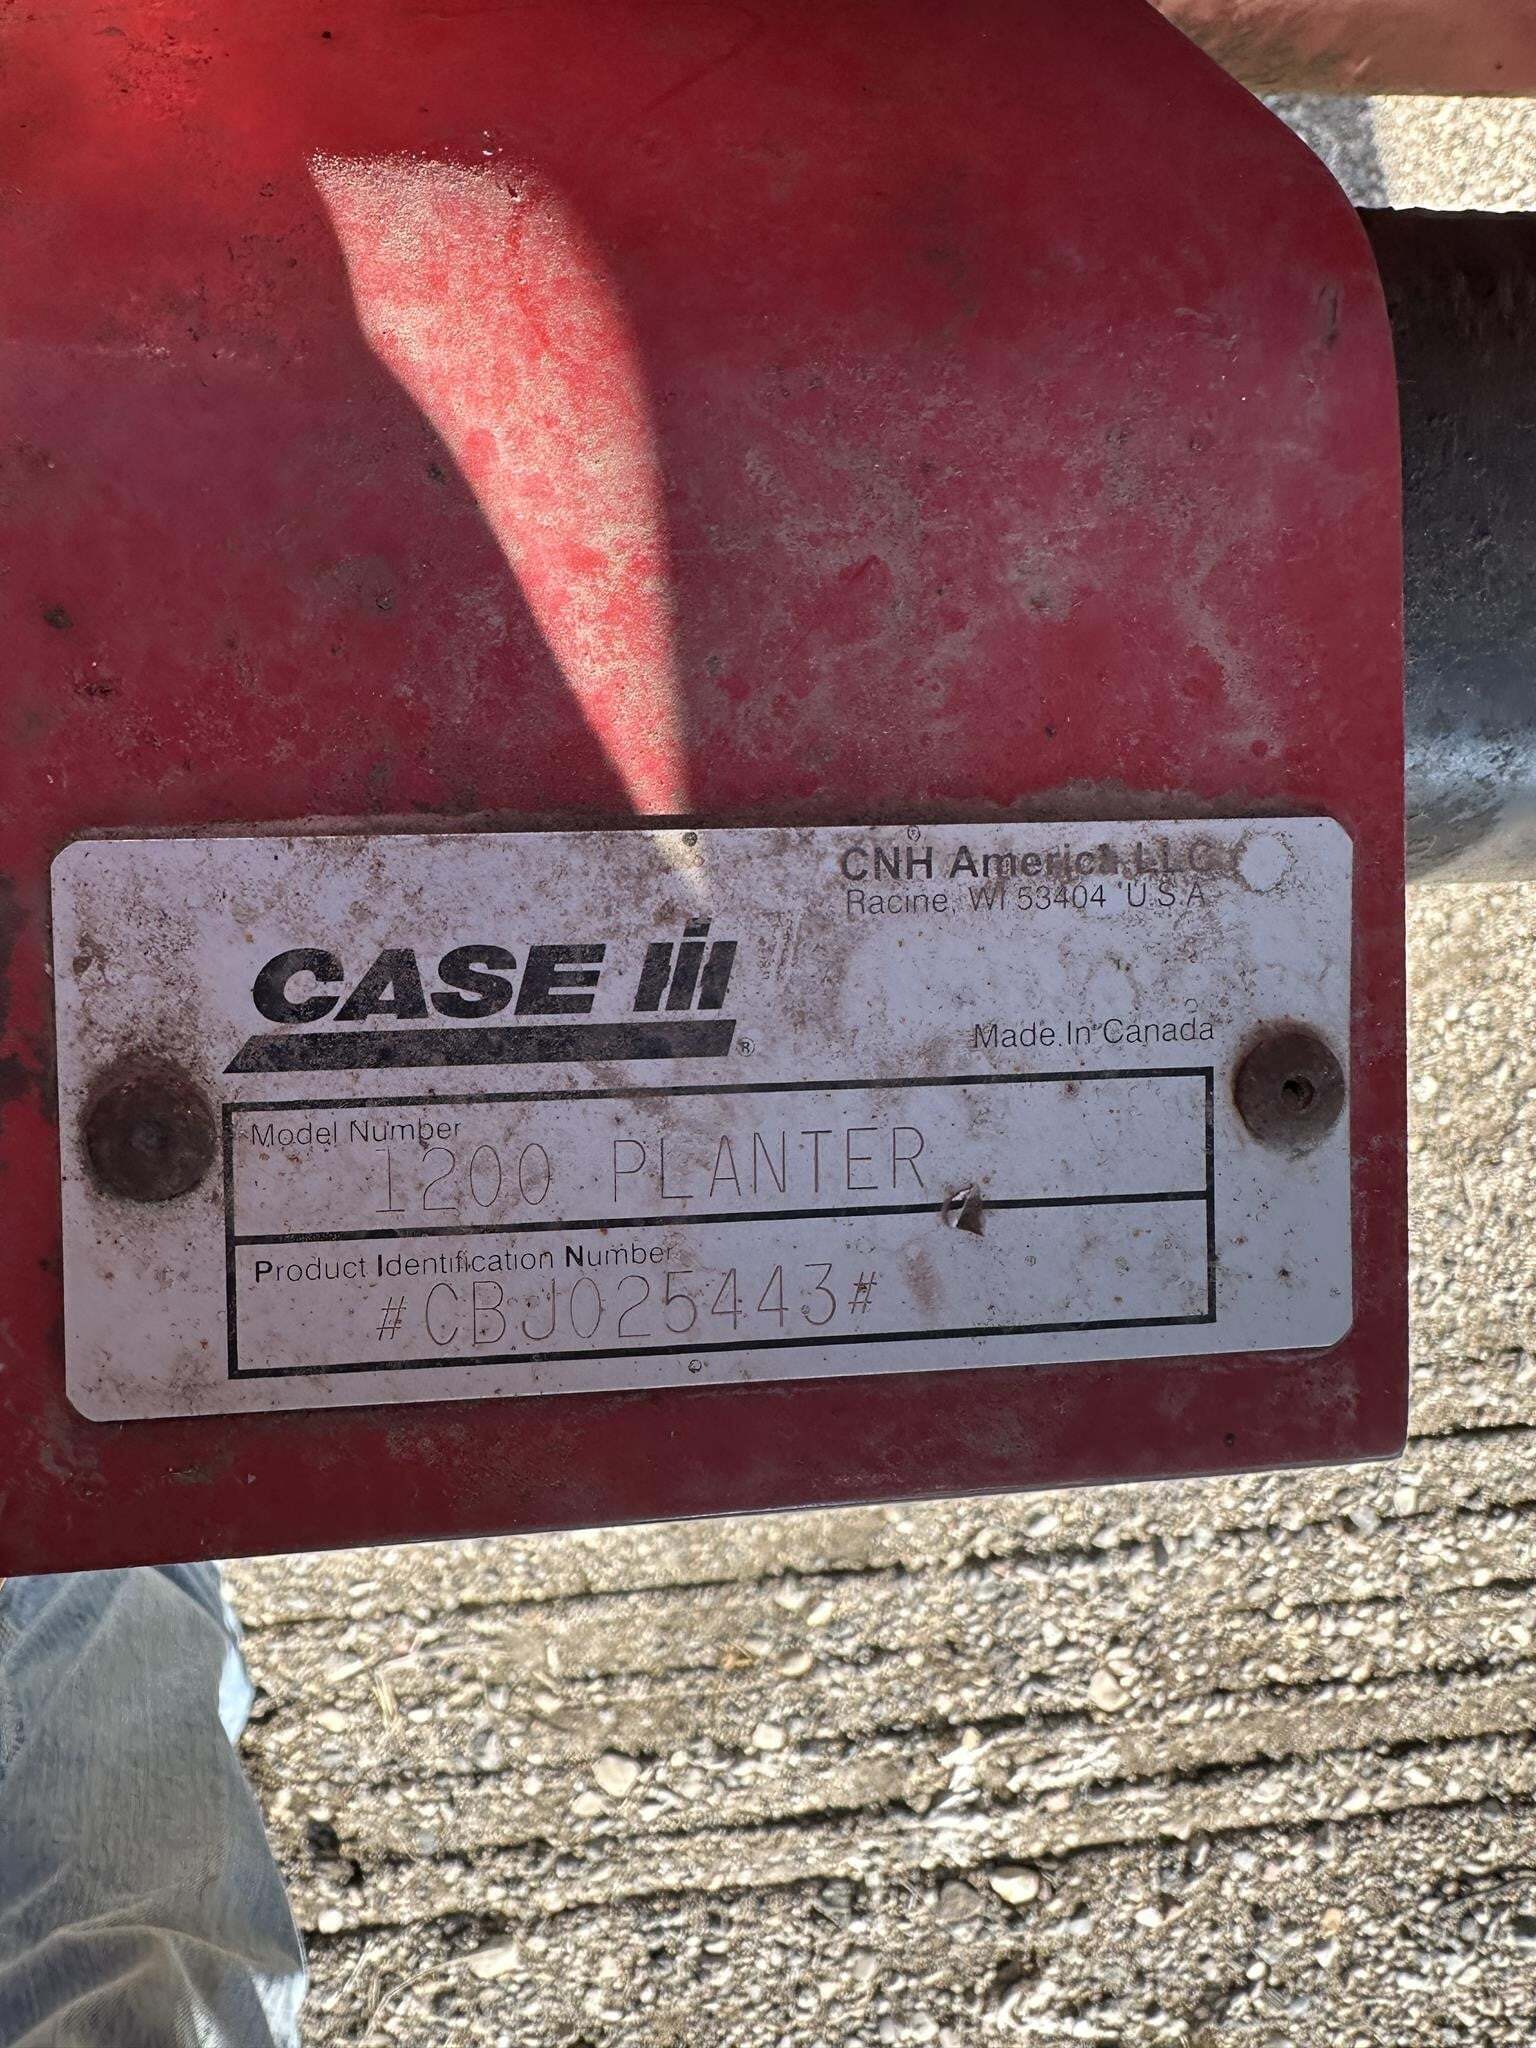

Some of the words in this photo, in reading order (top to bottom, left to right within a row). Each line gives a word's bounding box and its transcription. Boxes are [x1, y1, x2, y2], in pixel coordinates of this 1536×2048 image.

[842, 844, 933, 882] CNH
[949, 843, 1118, 880] Americ
[1134, 836, 1217, 874] LLC
[968, 886, 1006, 911] WI
[1017, 882, 1107, 911] 53404
[252, 943, 606, 1024] CASE
[973, 1021, 1056, 1048] Made
[1067, 1020, 1092, 1045] In
[1103, 1016, 1215, 1043] Canada
[251, 1122, 338, 1146] Model
[350, 1116, 463, 1143] Number
[375, 1142, 550, 1213] 1200
[613, 1126, 925, 1203] PLANTER
[255, 1257, 367, 1283] Product
[377, 1247, 554, 1277] Identification
[566, 1242, 673, 1268] Number
[376, 1262, 878, 1346] #CBJ025443#
